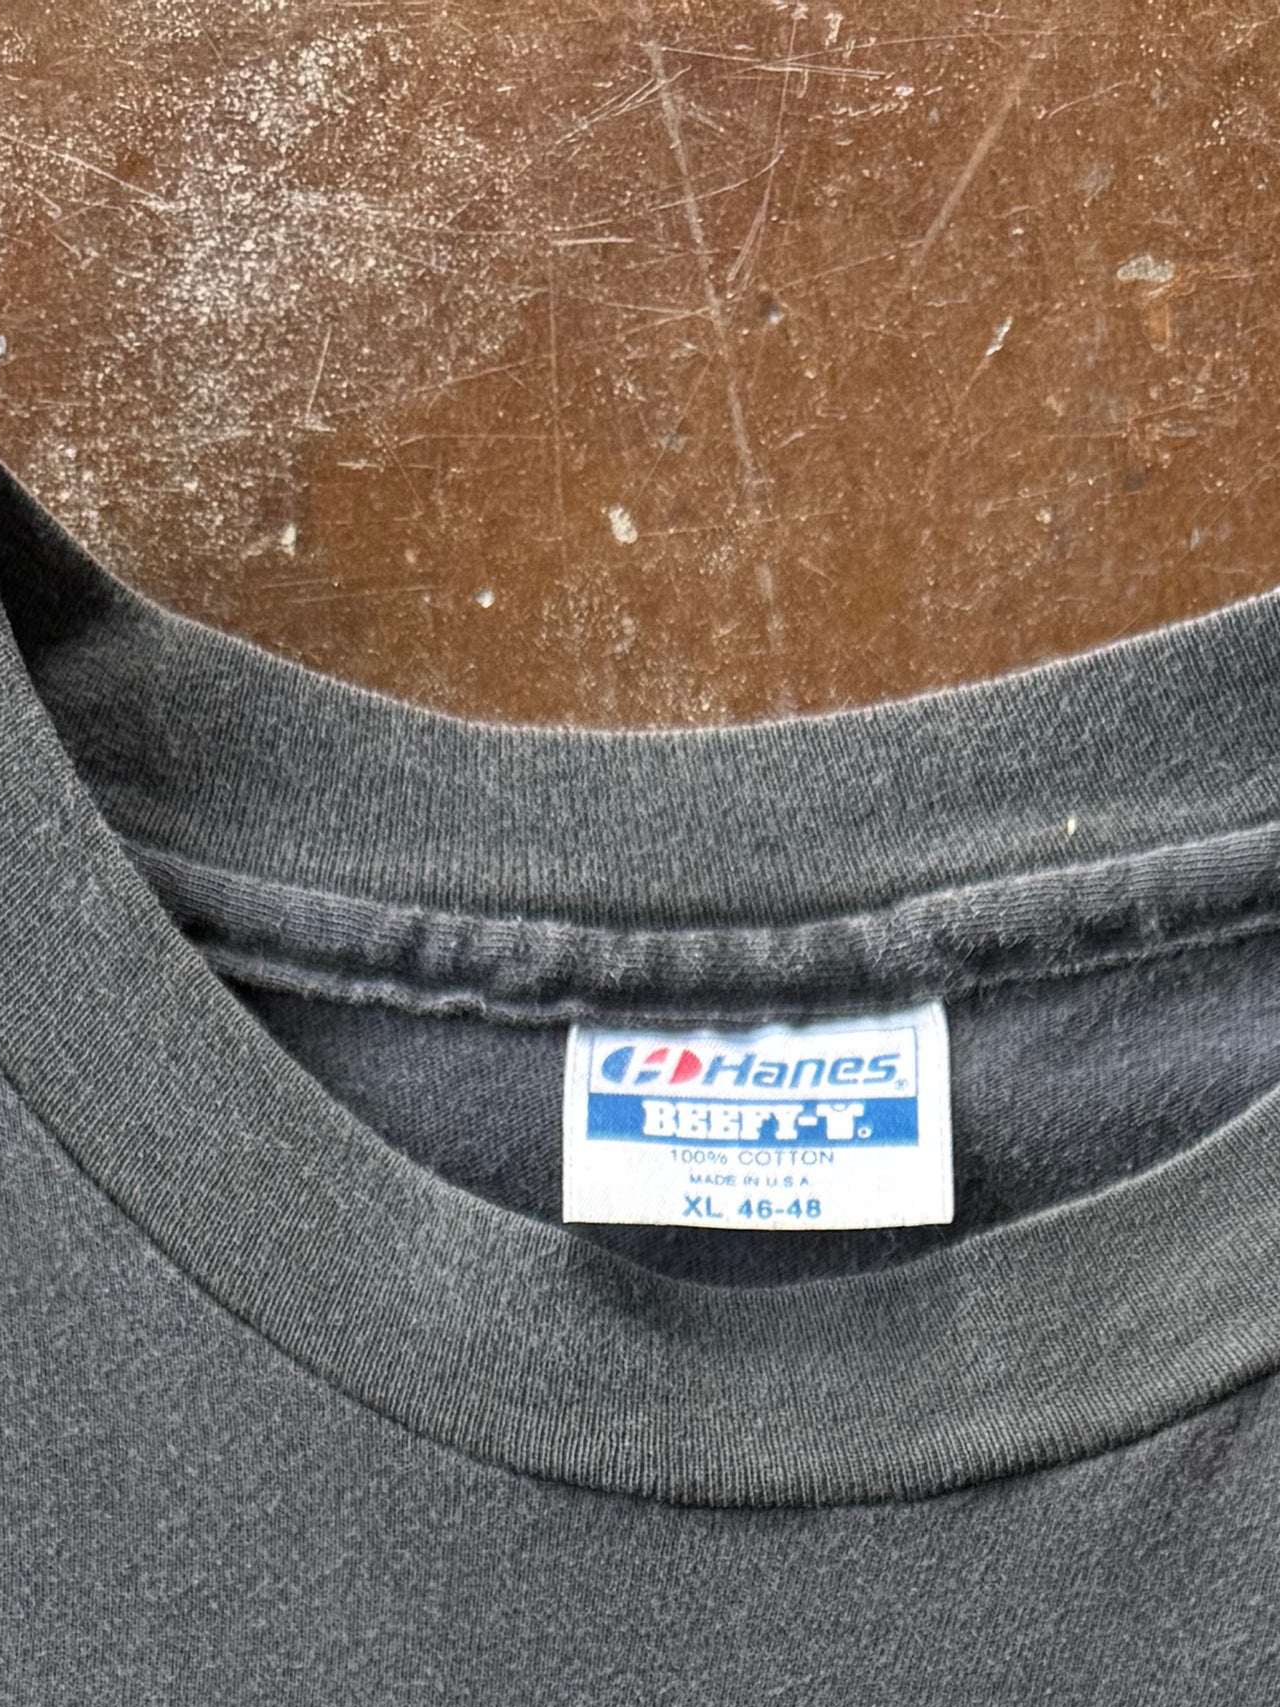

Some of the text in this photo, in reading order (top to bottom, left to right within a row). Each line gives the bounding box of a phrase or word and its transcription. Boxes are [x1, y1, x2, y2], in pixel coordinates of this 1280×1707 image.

[671, 1150, 834, 1166] 100% COTTON
[689, 1174, 736, 1187] MADE
[743, 1174, 760, 1188] IN
[683, 1195, 822, 1219] XL 46-48
